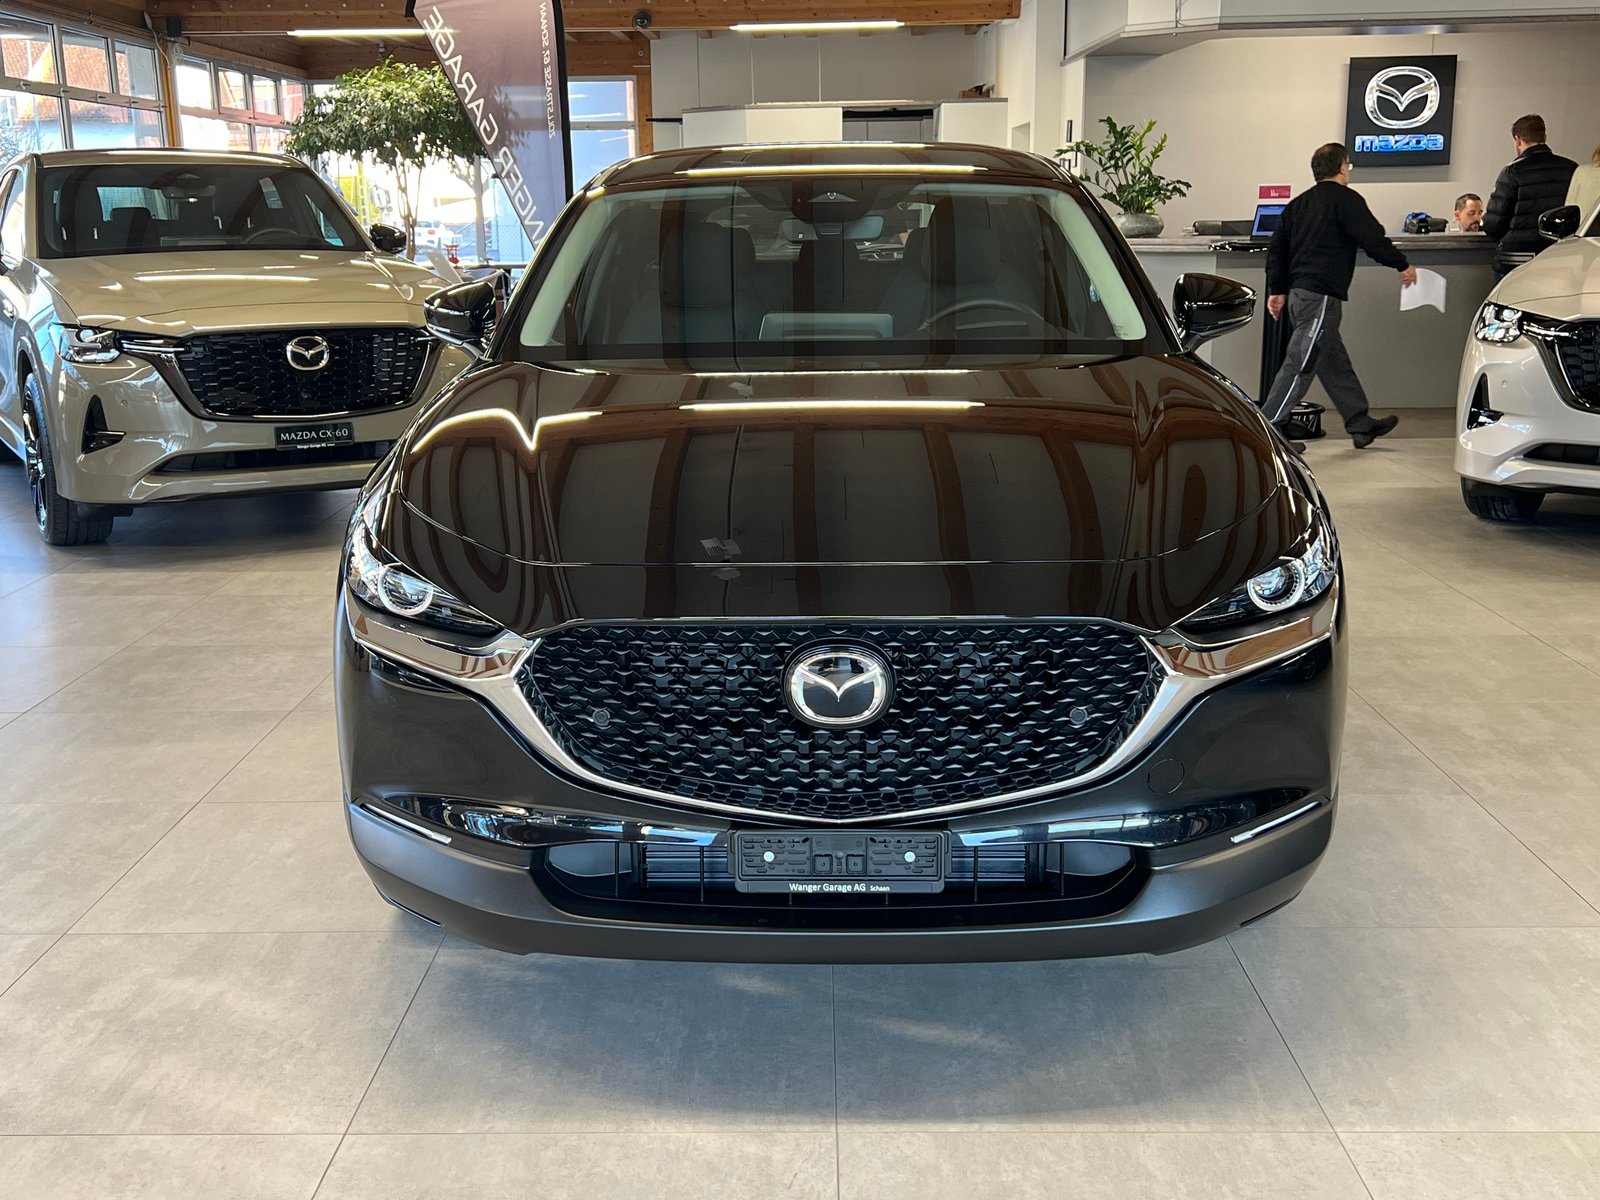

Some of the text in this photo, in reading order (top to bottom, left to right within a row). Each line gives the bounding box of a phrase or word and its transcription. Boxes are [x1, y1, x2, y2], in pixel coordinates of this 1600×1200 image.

[280, 428, 348, 441] MAZDA CX-60
[789, 883, 821, 893] Wanger
[823, 883, 852, 893] Garage
[854, 883, 866, 891] AG
